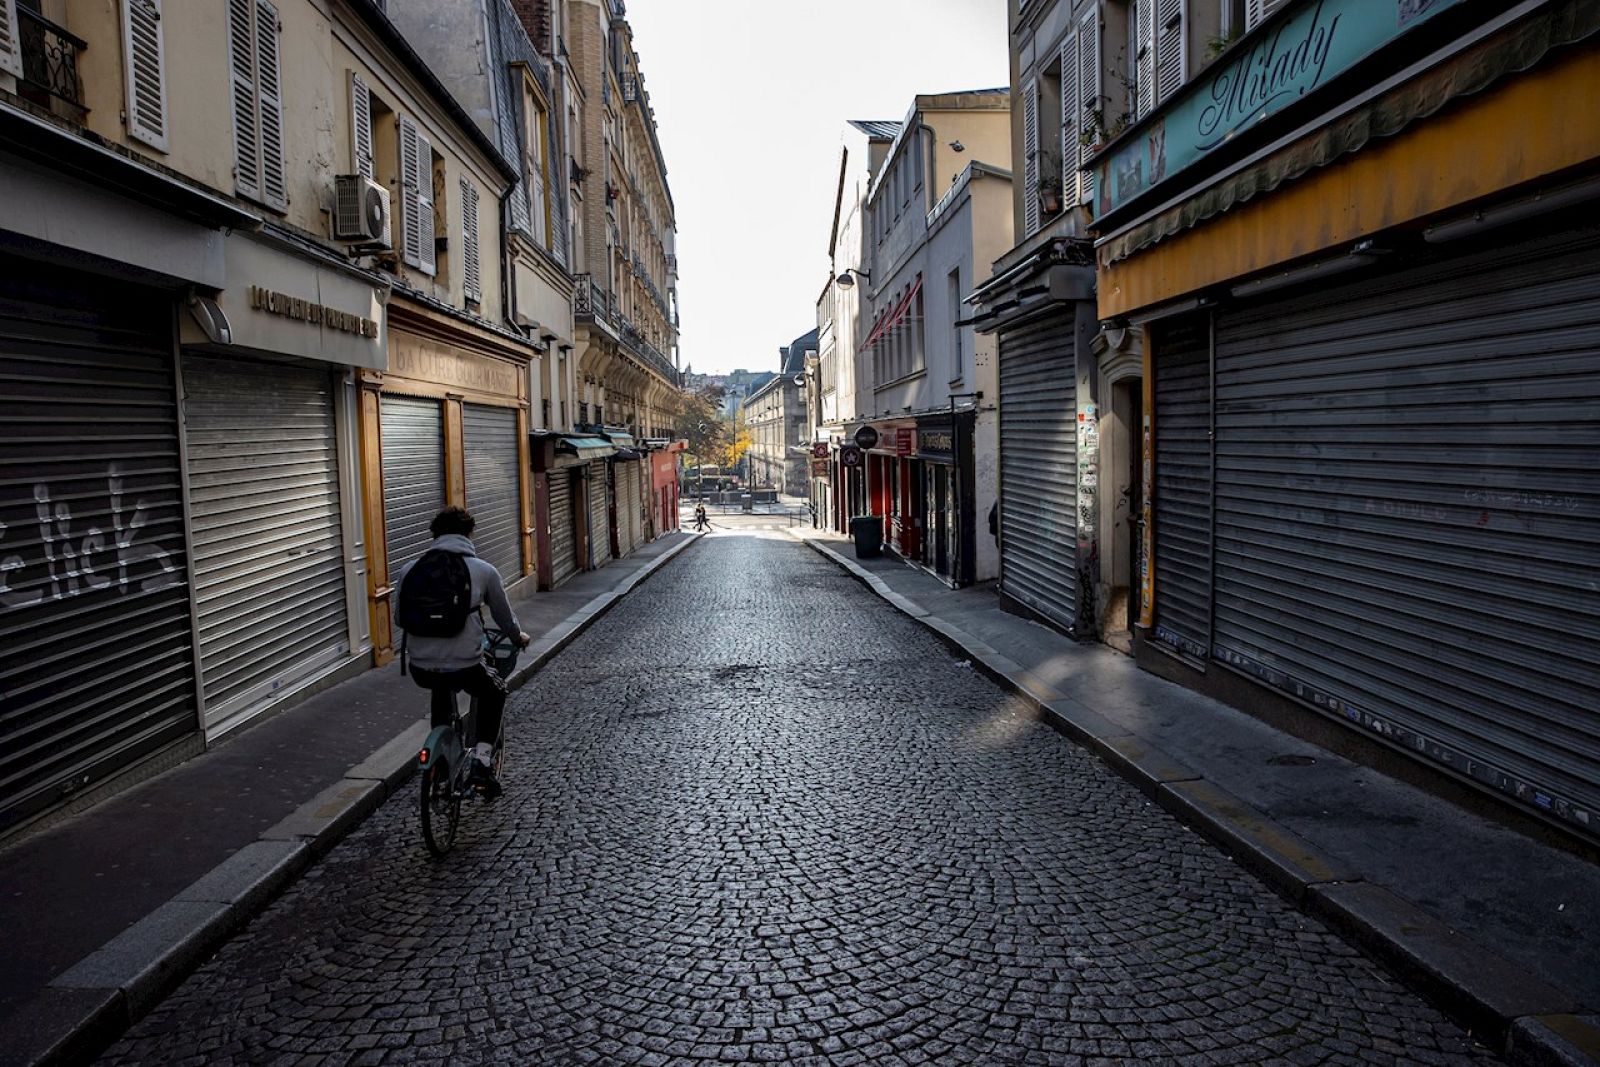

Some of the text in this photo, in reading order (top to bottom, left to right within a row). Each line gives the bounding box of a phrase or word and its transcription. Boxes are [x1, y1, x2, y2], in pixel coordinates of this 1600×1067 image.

[1198, 0, 1342, 137] Milady
[395, 338, 512, 392] LA CURE GOURMANDE
